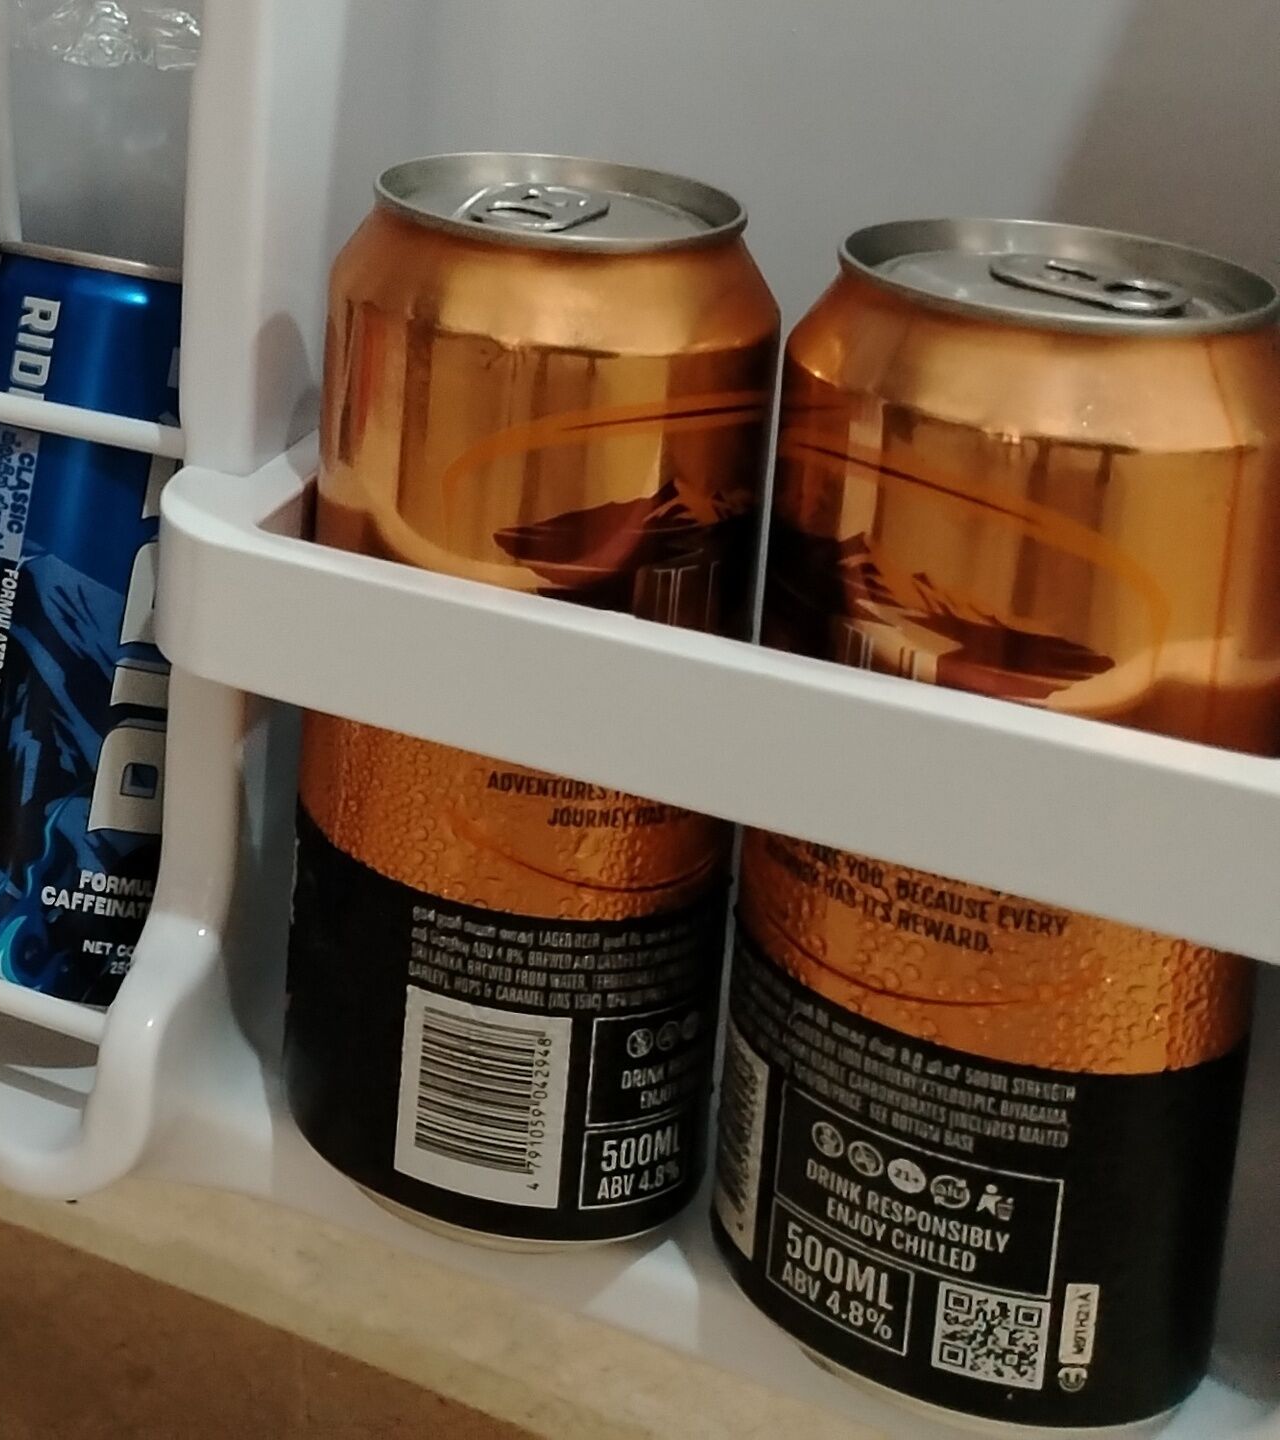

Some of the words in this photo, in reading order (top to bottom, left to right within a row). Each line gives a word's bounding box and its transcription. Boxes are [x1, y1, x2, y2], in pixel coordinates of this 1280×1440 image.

[6, 452, 37, 535] CLASSIC
[487, 769, 608, 802] ADVENTURES
[546, 805, 628, 831] JOURNEY
[895, 877, 991, 924] BECAUSE
[997, 905, 1069, 938] EVERY
[897, 908, 995, 956] REWARD.
[82, 939, 111, 956] NET
[532, 1037, 553, 1101] 042948
[527, 1107, 546, 1171] 791059
[596, 1173, 636, 1201] ABV
[805, 1157, 862, 1205] DRINK
[866, 1189, 1011, 1254] RESPONSIBLY
[786, 1220, 894, 1311] 500ML
[826, 1195, 887, 1242] ENJOY
[890, 1226, 977, 1273] CHILLED
[781, 1260, 822, 1302] ABV
[825, 1289, 893, 1341] 4.8%
